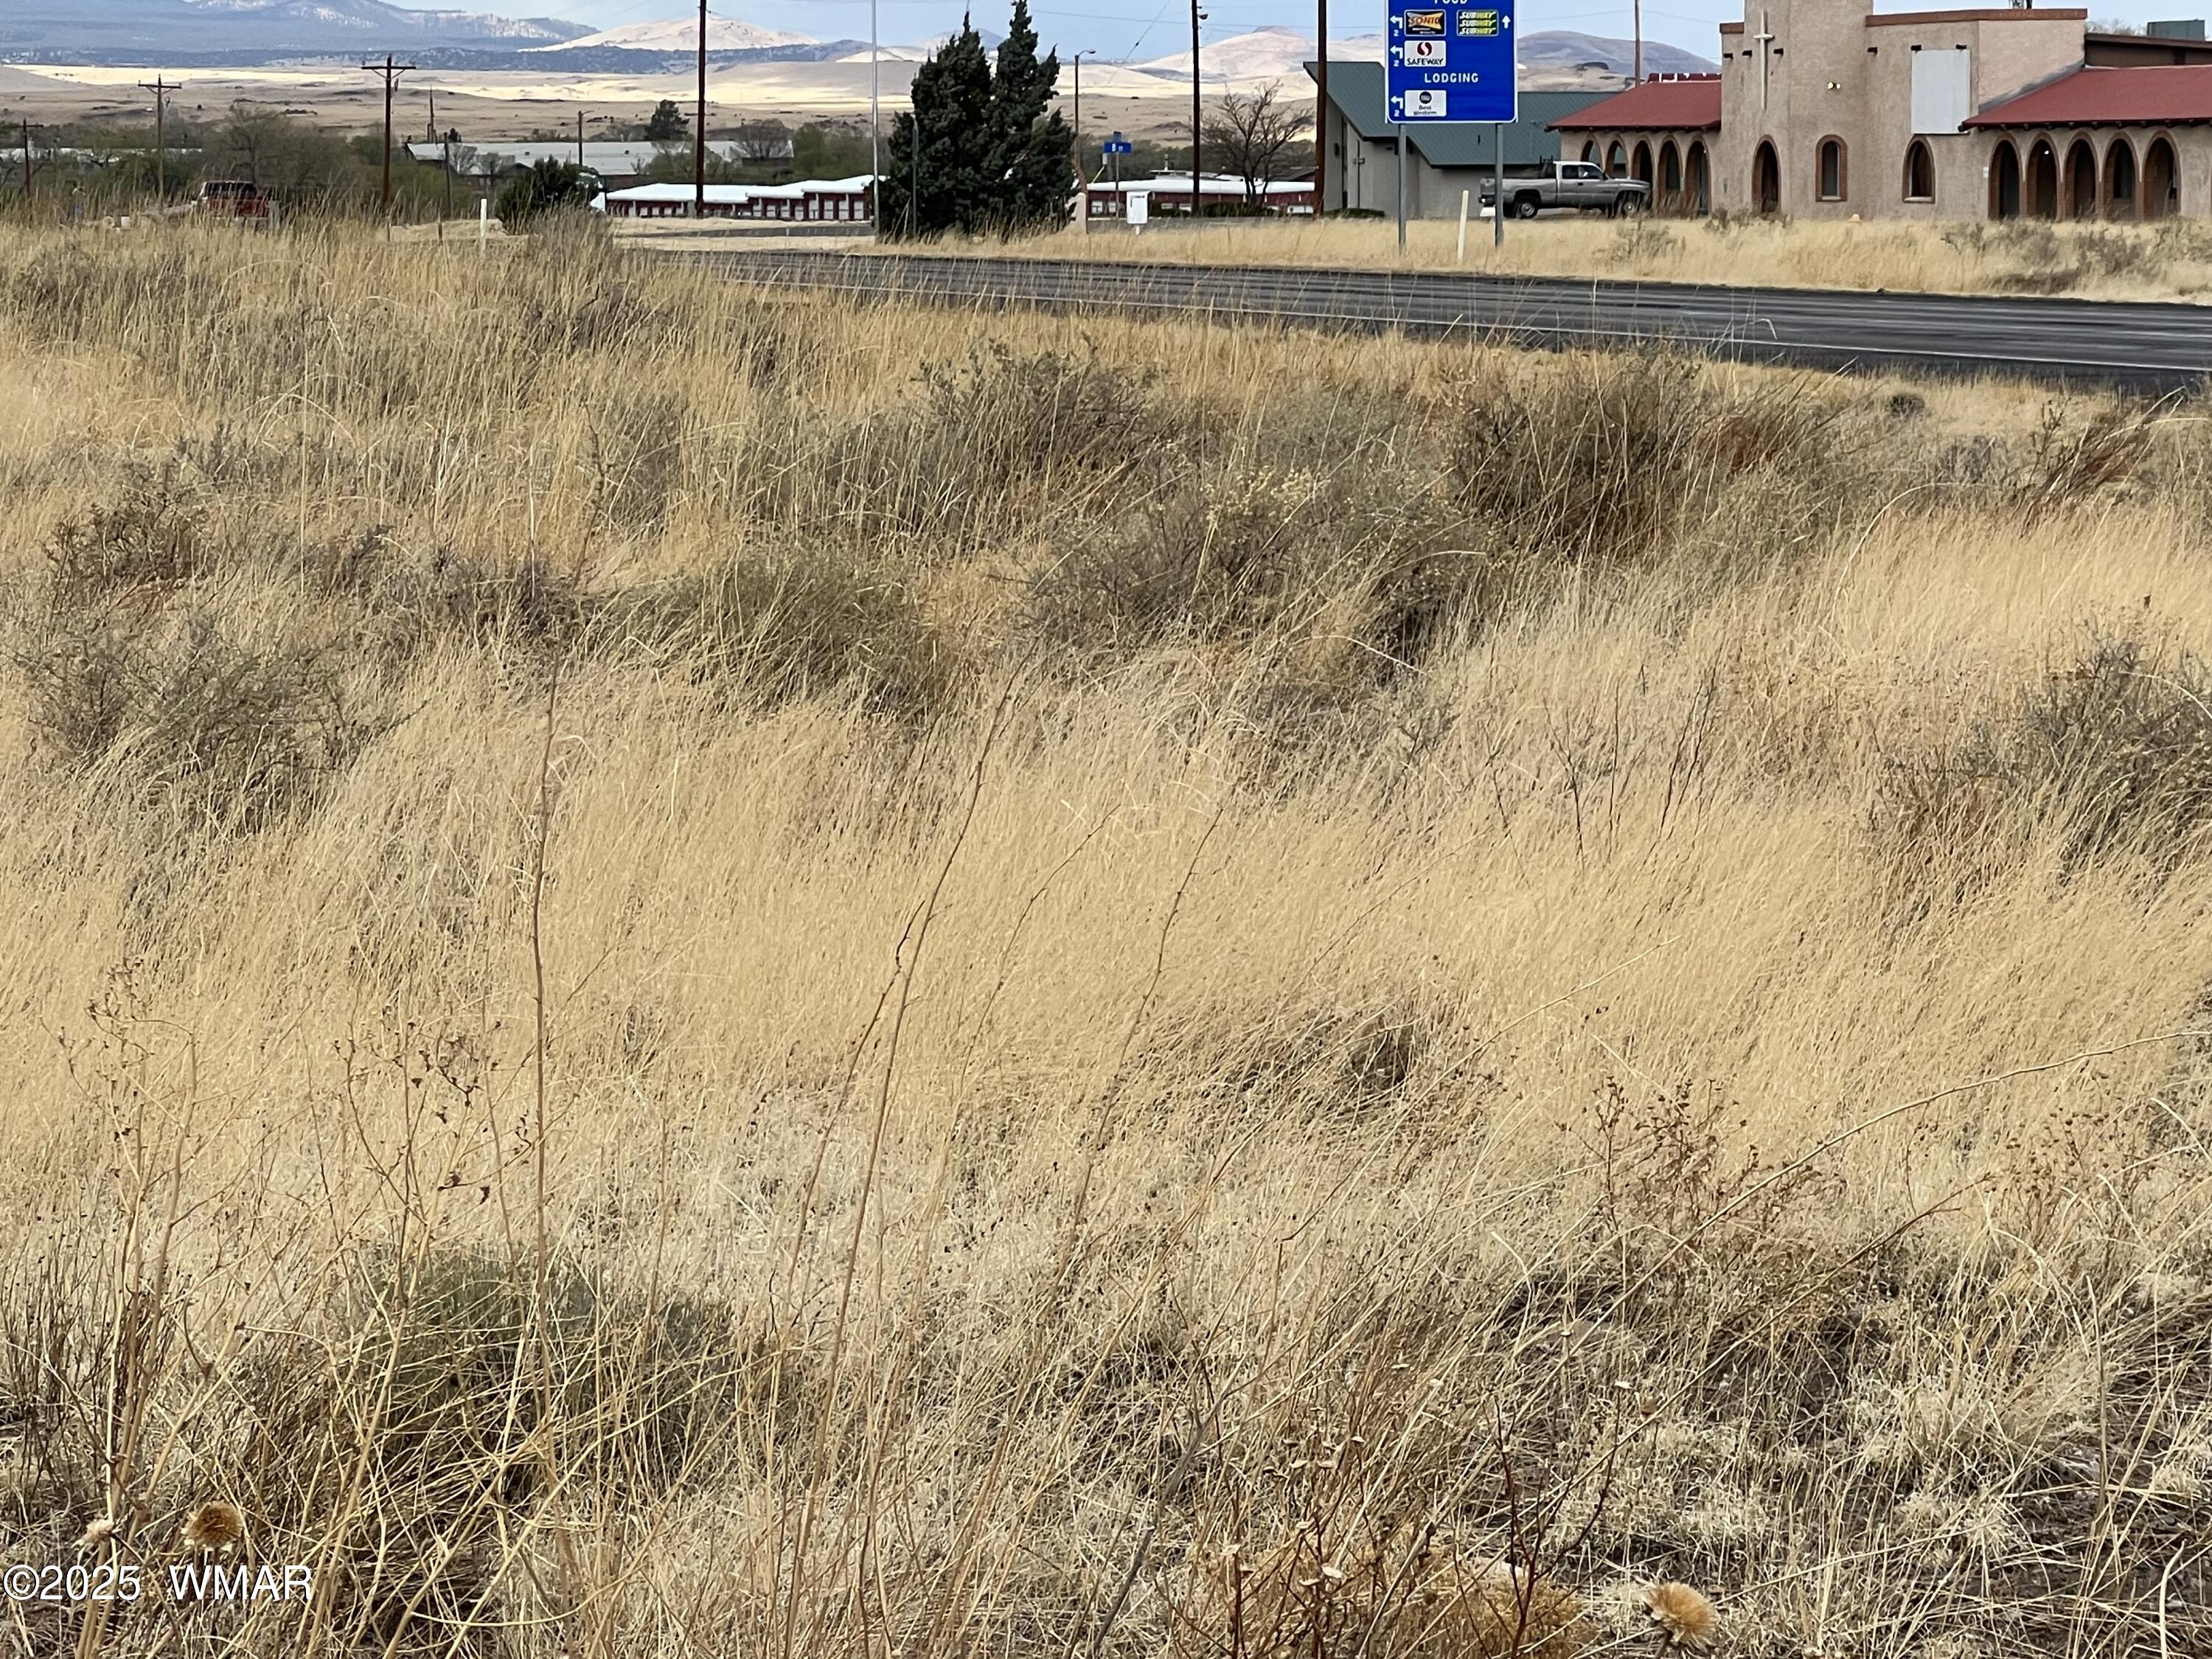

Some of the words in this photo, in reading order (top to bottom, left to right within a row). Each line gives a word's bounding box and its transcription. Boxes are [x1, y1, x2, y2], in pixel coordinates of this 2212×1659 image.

[1459, 11, 1496, 19] SUBWAY
[1410, 15, 1441, 24] SONIC
[1407, 58, 1444, 66] SAFEWAY
[1424, 72, 1479, 83] LODGING
[1394, 109, 1400, 117] 2
